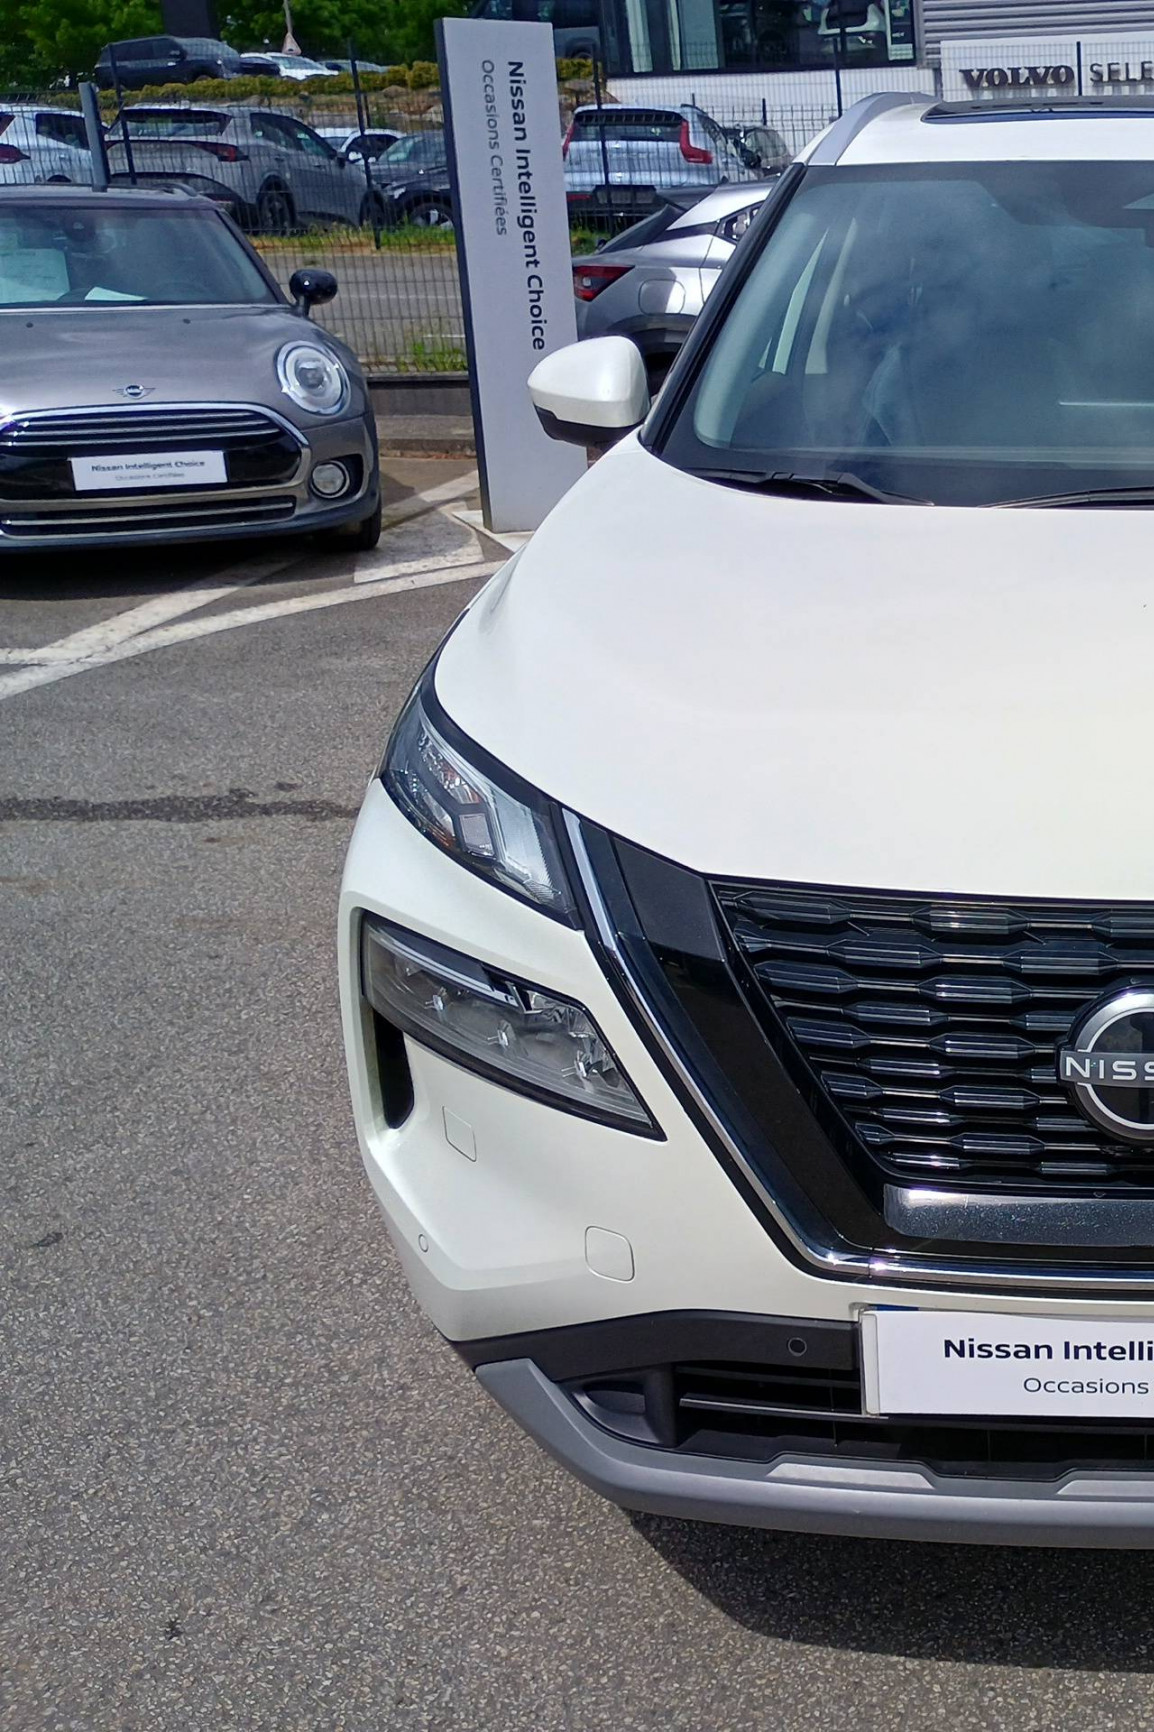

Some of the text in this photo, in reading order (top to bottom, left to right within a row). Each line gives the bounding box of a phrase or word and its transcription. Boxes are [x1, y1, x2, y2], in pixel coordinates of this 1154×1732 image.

[959, 65, 1075, 88] VOLVO
[482, 60, 509, 235] Occasions Certifiées
[508, 61, 547, 350] Nissan Intelligent Choice
[91, 460, 205, 472] Nissan Intelligent Choice
[943, 1338, 1053, 1360] Nissan
[1023, 1377, 1149, 1396] Occasions
